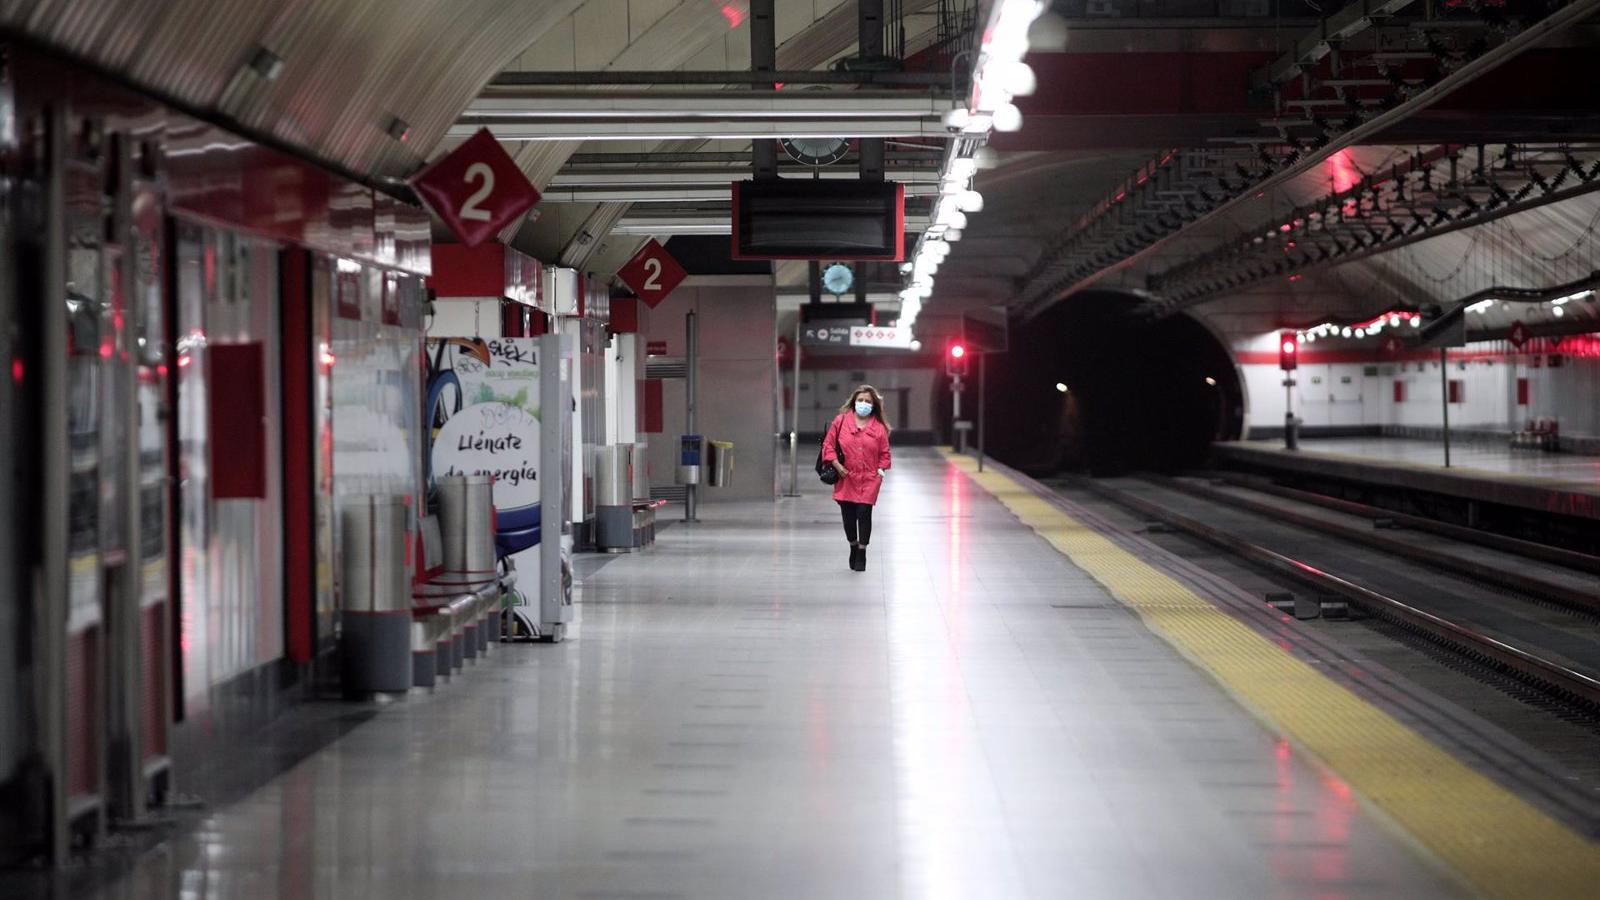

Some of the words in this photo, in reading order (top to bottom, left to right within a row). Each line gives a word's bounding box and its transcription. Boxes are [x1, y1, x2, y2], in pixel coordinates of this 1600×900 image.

[459, 161, 495, 221] 2
[643, 257, 662, 290] 2
[458, 431, 521, 453] Llénate
